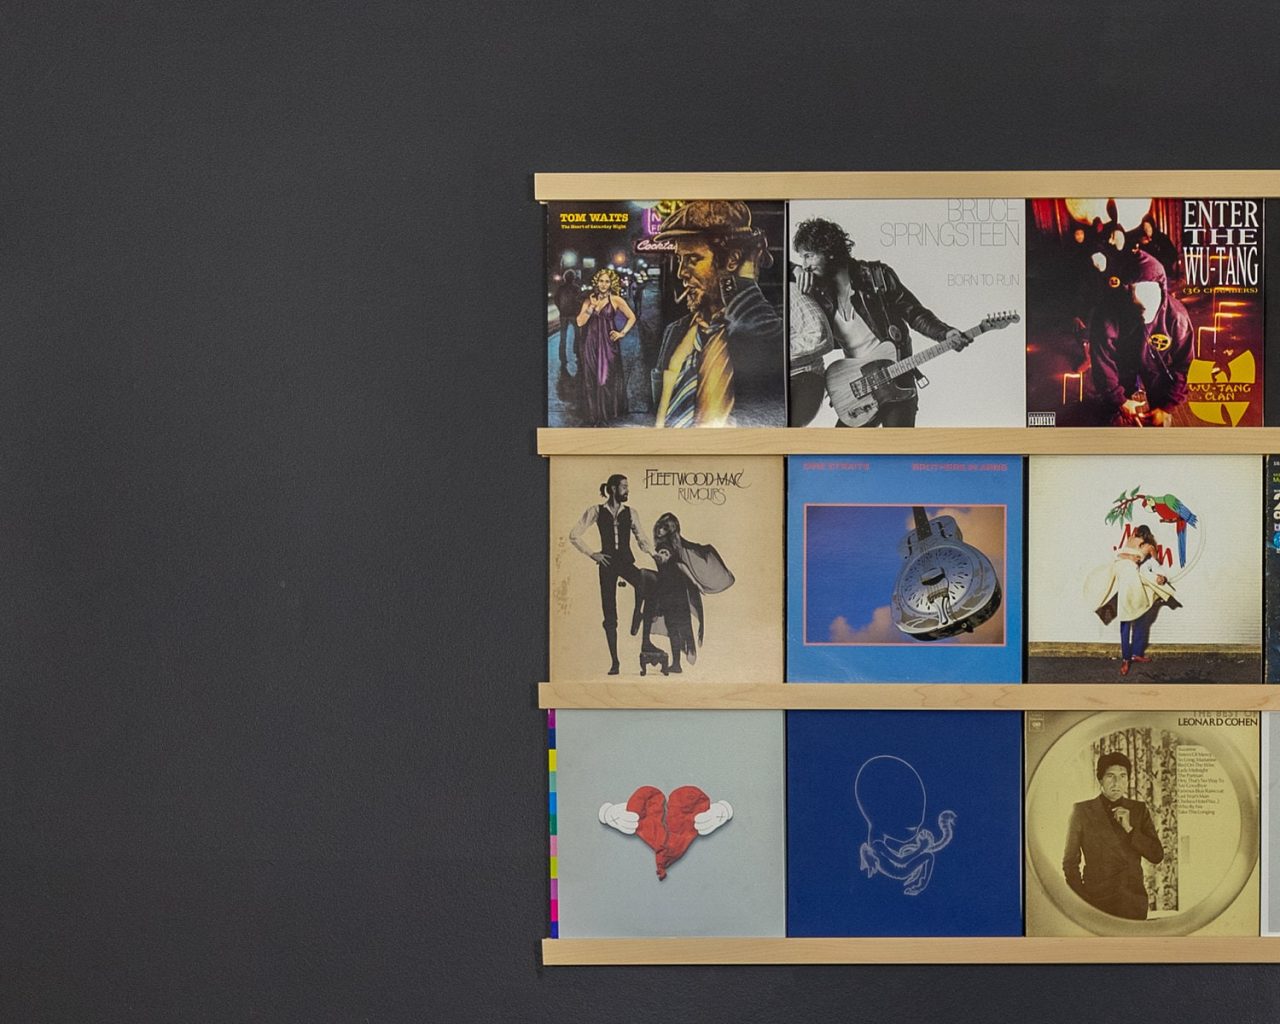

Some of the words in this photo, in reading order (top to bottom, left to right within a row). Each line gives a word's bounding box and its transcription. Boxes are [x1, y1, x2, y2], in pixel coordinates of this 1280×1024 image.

[560, 213, 586, 222] TOM
[589, 213, 629, 222] WAITS
[947, 198, 1020, 221] BRUCE
[1184, 200, 1259, 228] ENTER
[880, 222, 1020, 247] SPRINGSTEEN
[1184, 229, 1257, 245] THE
[1183, 247, 1259, 286] WU-TANG
[947, 273, 978, 287] BORN
[981, 273, 993, 287] TO
[996, 273, 1020, 287] RUN
[643, 469, 714, 489] FLEETWOOD
[1178, 718, 1224, 727] LEONARD
[1224, 718, 1258, 727] COHEN
